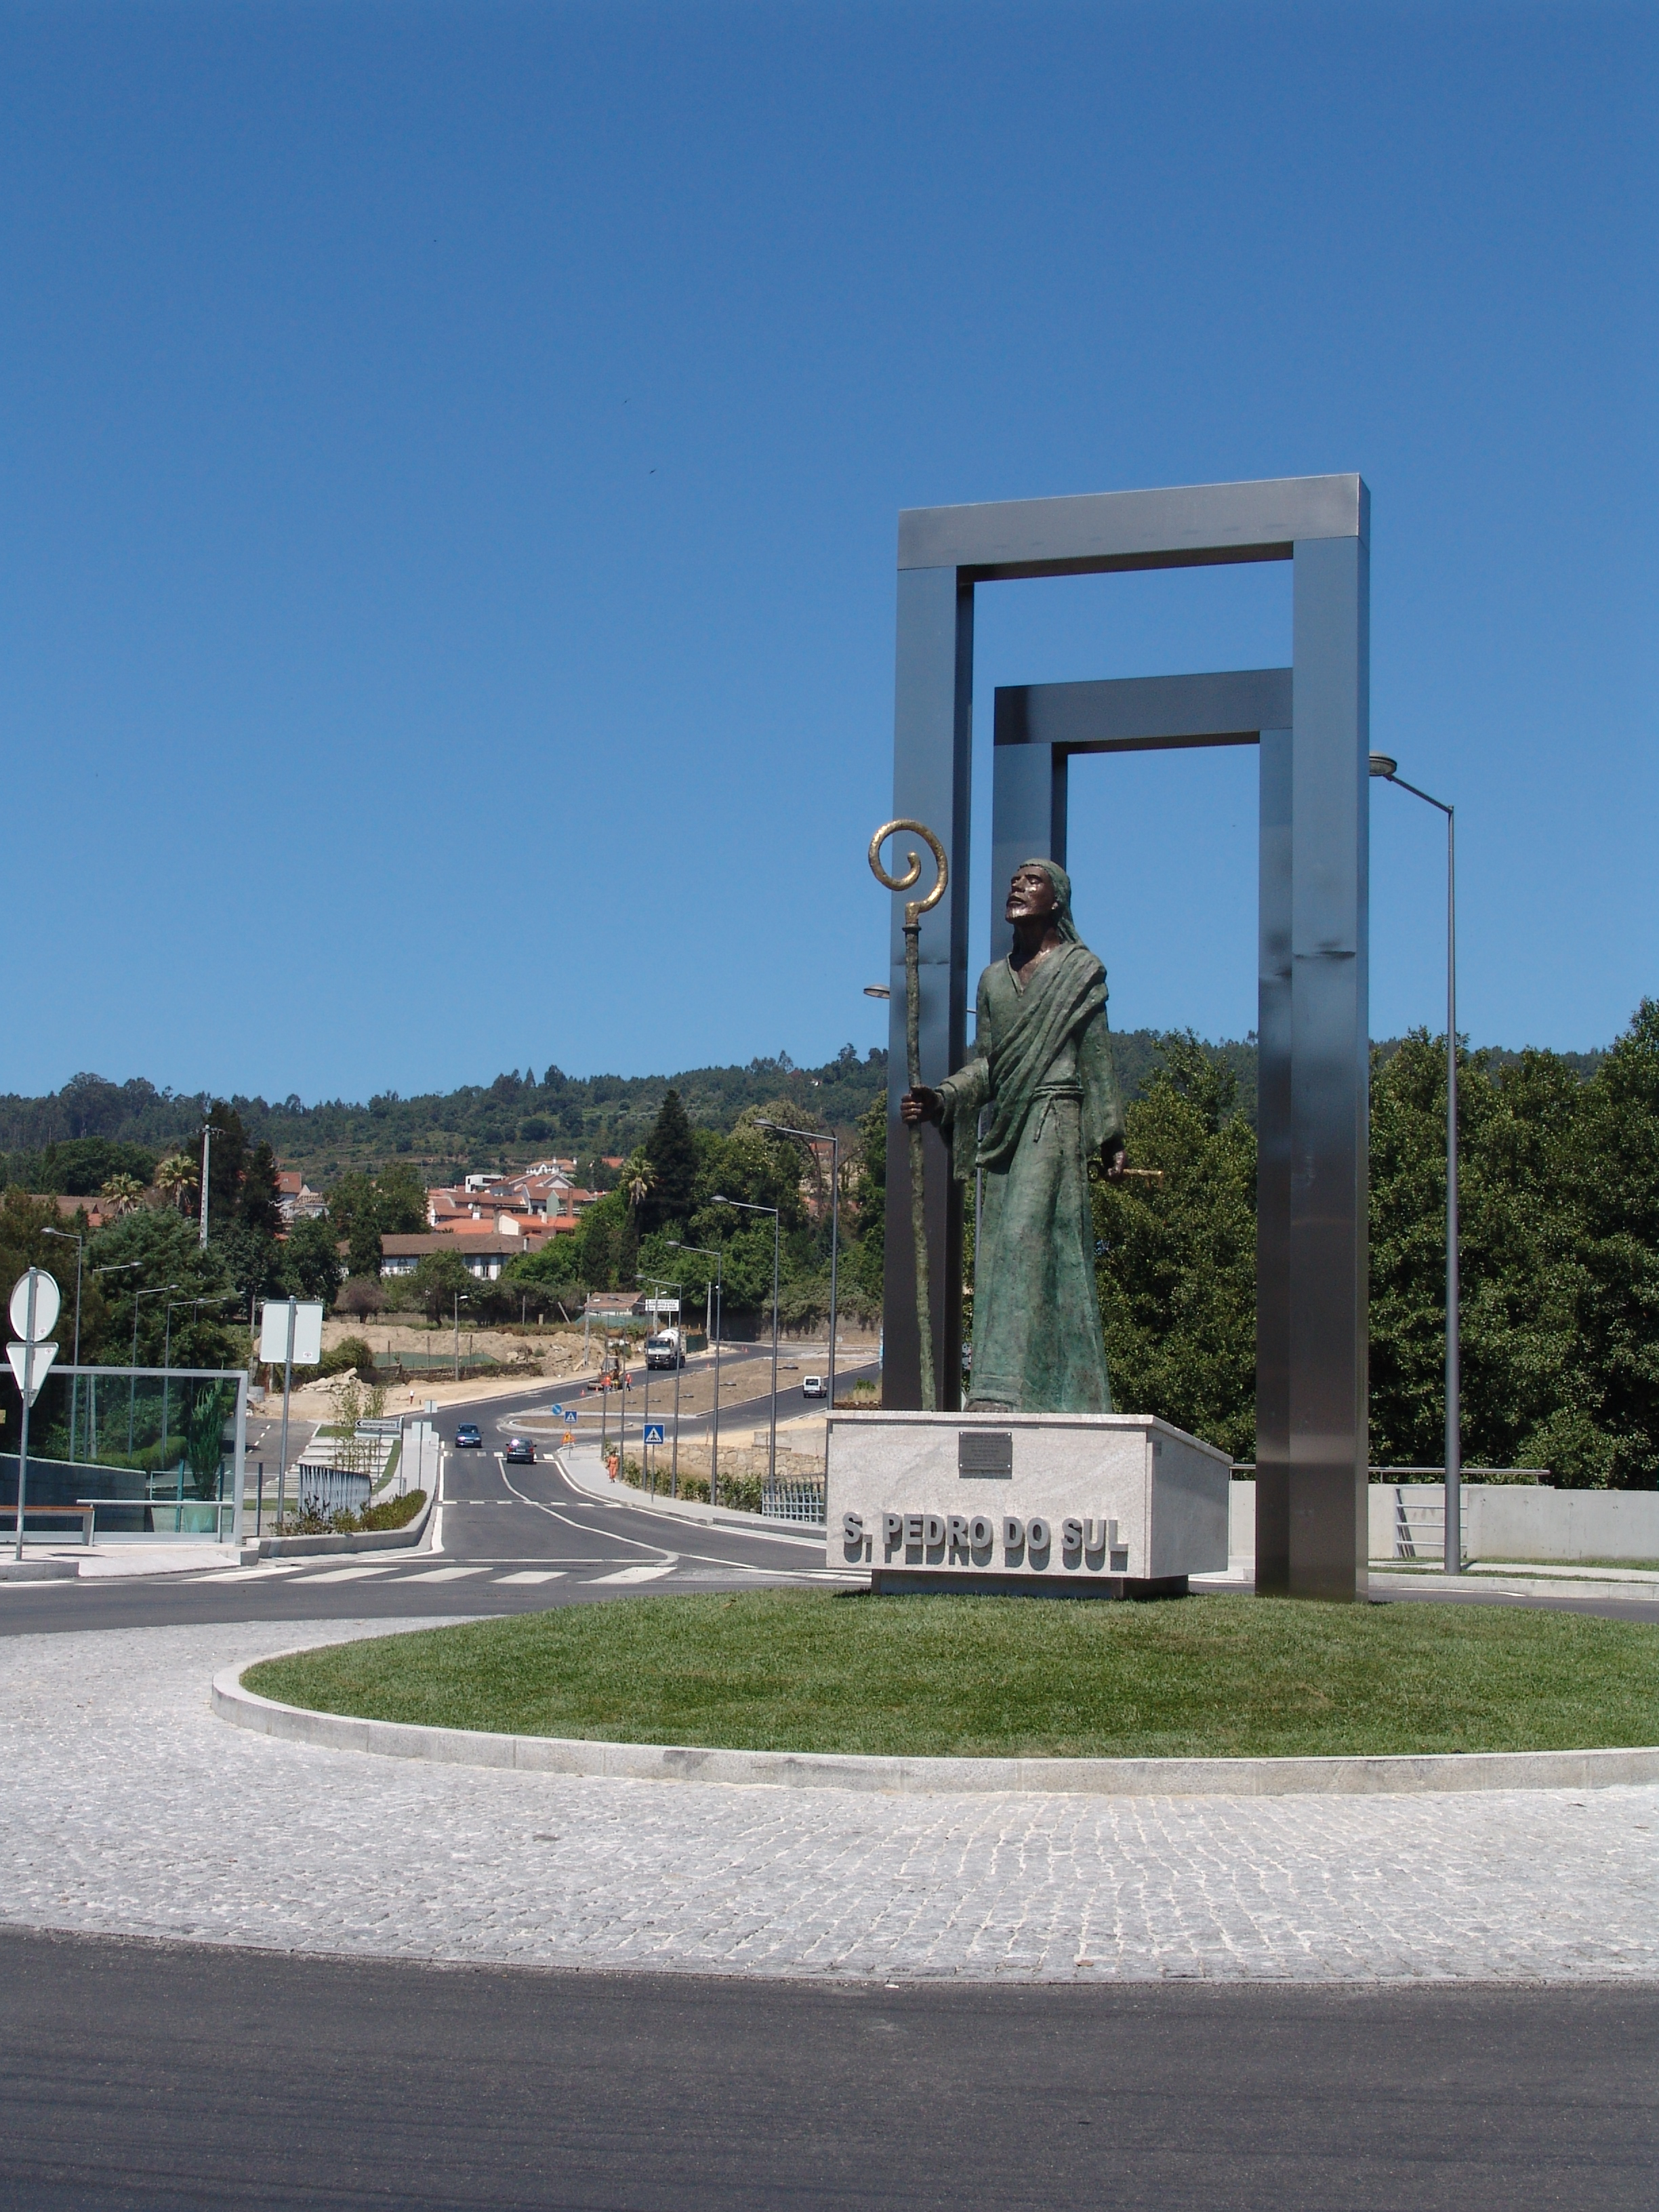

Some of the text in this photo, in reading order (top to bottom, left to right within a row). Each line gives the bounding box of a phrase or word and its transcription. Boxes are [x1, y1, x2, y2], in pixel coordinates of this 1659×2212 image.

[842, 1511, 1128, 1552] S. PEDRO DO SUL
